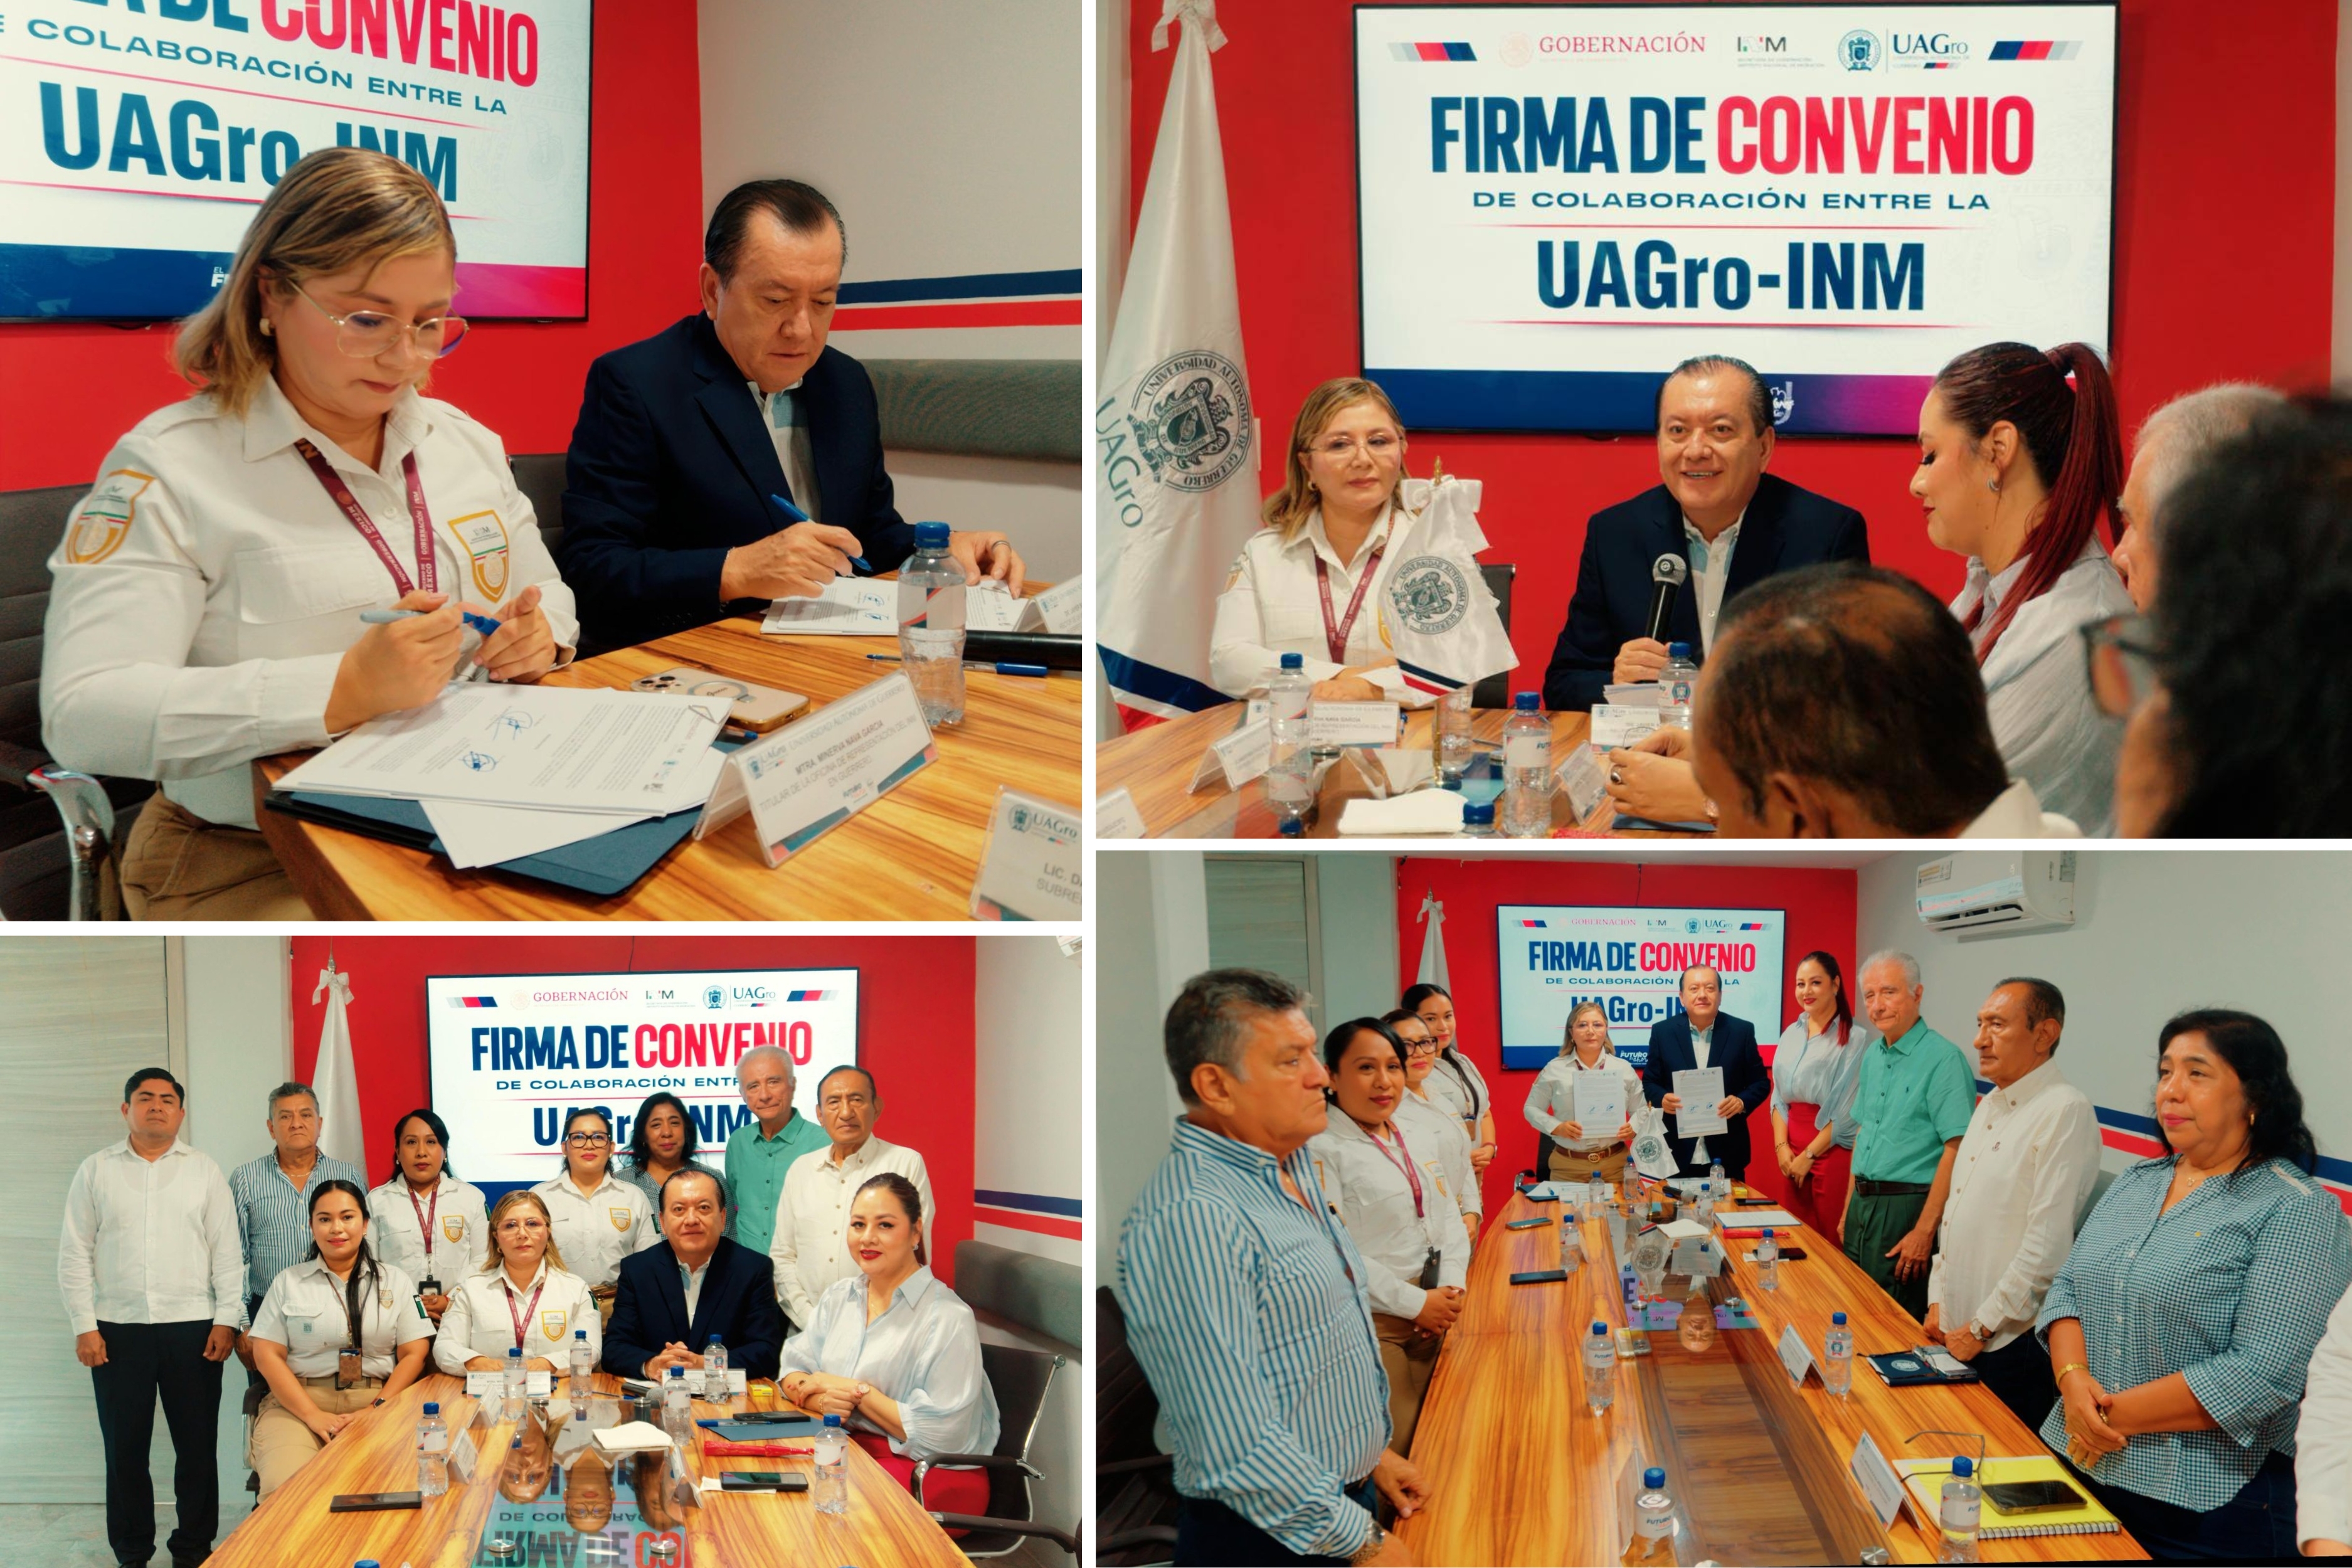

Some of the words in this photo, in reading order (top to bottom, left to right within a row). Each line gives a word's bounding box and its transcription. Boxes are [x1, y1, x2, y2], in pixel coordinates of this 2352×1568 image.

[1540, 31, 1705, 53] GOBERNACIÓN
[1894, 33, 1968, 54] UAGro
[27, 18, 352, 89] COLABORACIÓN
[368, 76, 462, 107] ENTRE
[474, 95, 507, 114] LA
[1431, 97, 1619, 173] FIRMA
[1629, 97, 1706, 174] DE
[1718, 95, 2034, 175] CONVENIO
[1473, 192, 1515, 208] DE
[1532, 188, 1806, 209] COLABORACIÓN
[1823, 193, 1931, 209] ENTRE
[1948, 194, 1989, 209] LA
[1537, 240, 1924, 310] UAGro-INM
[1143, 357, 1217, 396] UNIVERSIDAD
[1096, 396, 1143, 528] UAGro
[837, 755, 872, 782] GUERRERO
[1034, 813, 1078, 838] UAGro
[1043, 862, 1067, 881] LIC.
[1037, 877, 1082, 904] SUBRE
[1572, 918, 1636, 926] GOBERNACIÓN
[1529, 941, 1602, 971] FIRMA
[1607, 942, 1636, 971] DE
[734, 987, 776, 999] UAGro
[1569, 977, 1673, 985] COLABORACIÓN
[534, 988, 628, 1002] GOBERNACIÓN
[472, 1026, 578, 1071] FIRMA
[585, 1024, 628, 1068] DE
[497, 1081, 521, 1090] DE
[530, 1075, 686, 1089] COLABORACIÓN
